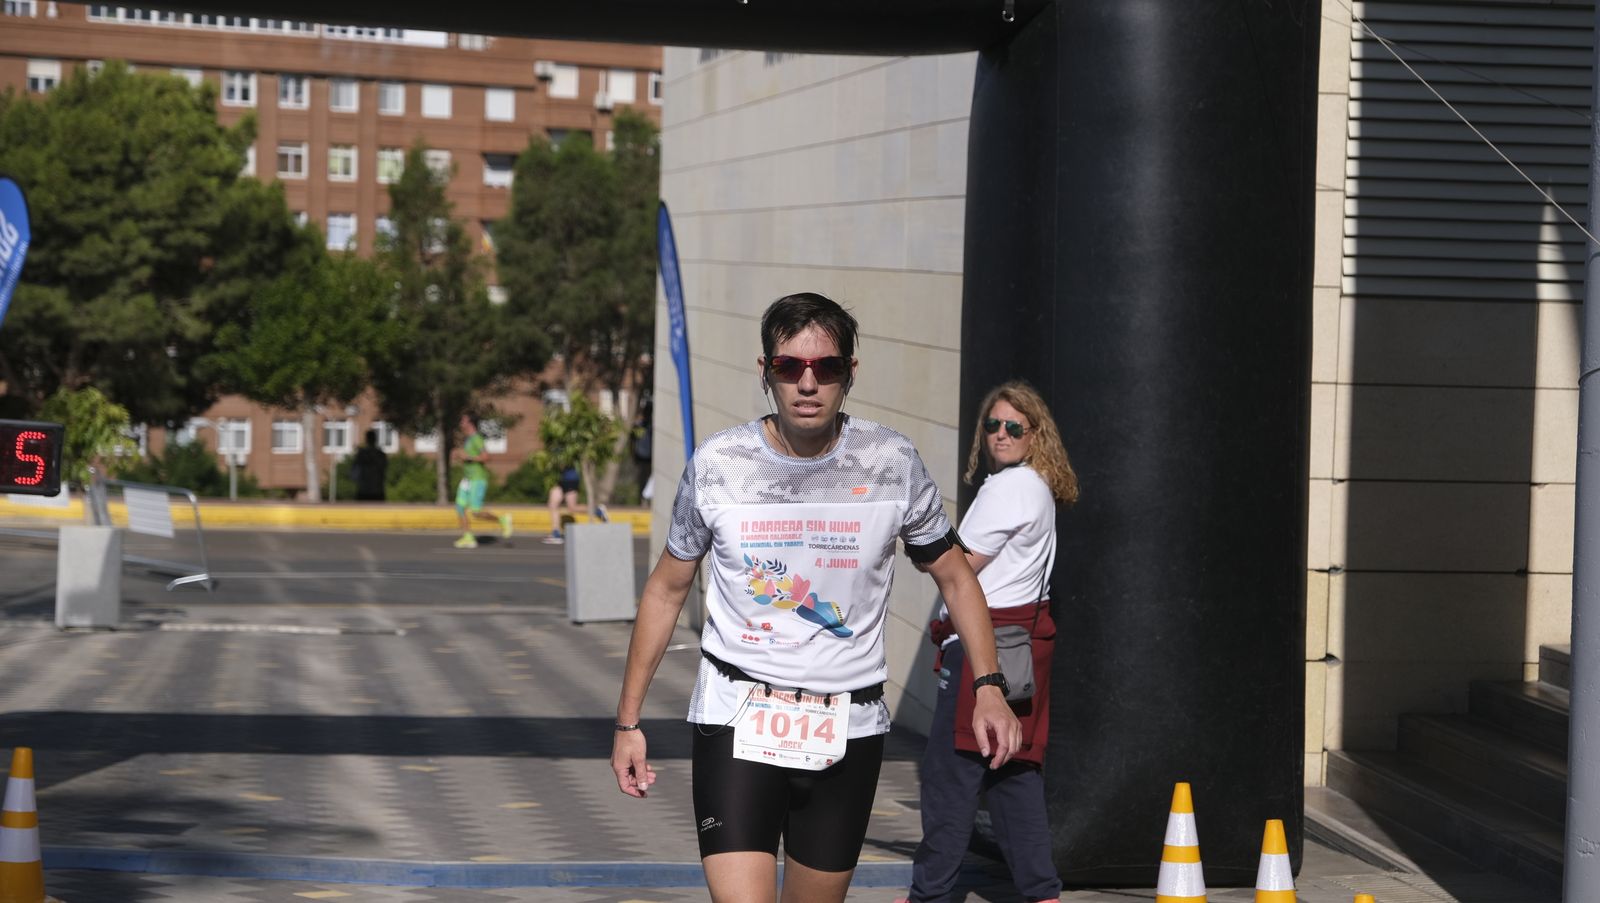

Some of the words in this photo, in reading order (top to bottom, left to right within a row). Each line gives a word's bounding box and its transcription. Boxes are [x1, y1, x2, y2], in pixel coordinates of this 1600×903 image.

[15, 431, 46, 485] 5
[741, 521, 749, 533] II
[751, 520, 803, 532] CARRERA
[806, 520, 826, 532] SIN
[829, 521, 861, 533] HUMO
[815, 557, 822, 568] 4
[827, 558, 858, 569] JUNIO
[814, 694, 839, 706] HUO
[750, 709, 836, 744] 1014
